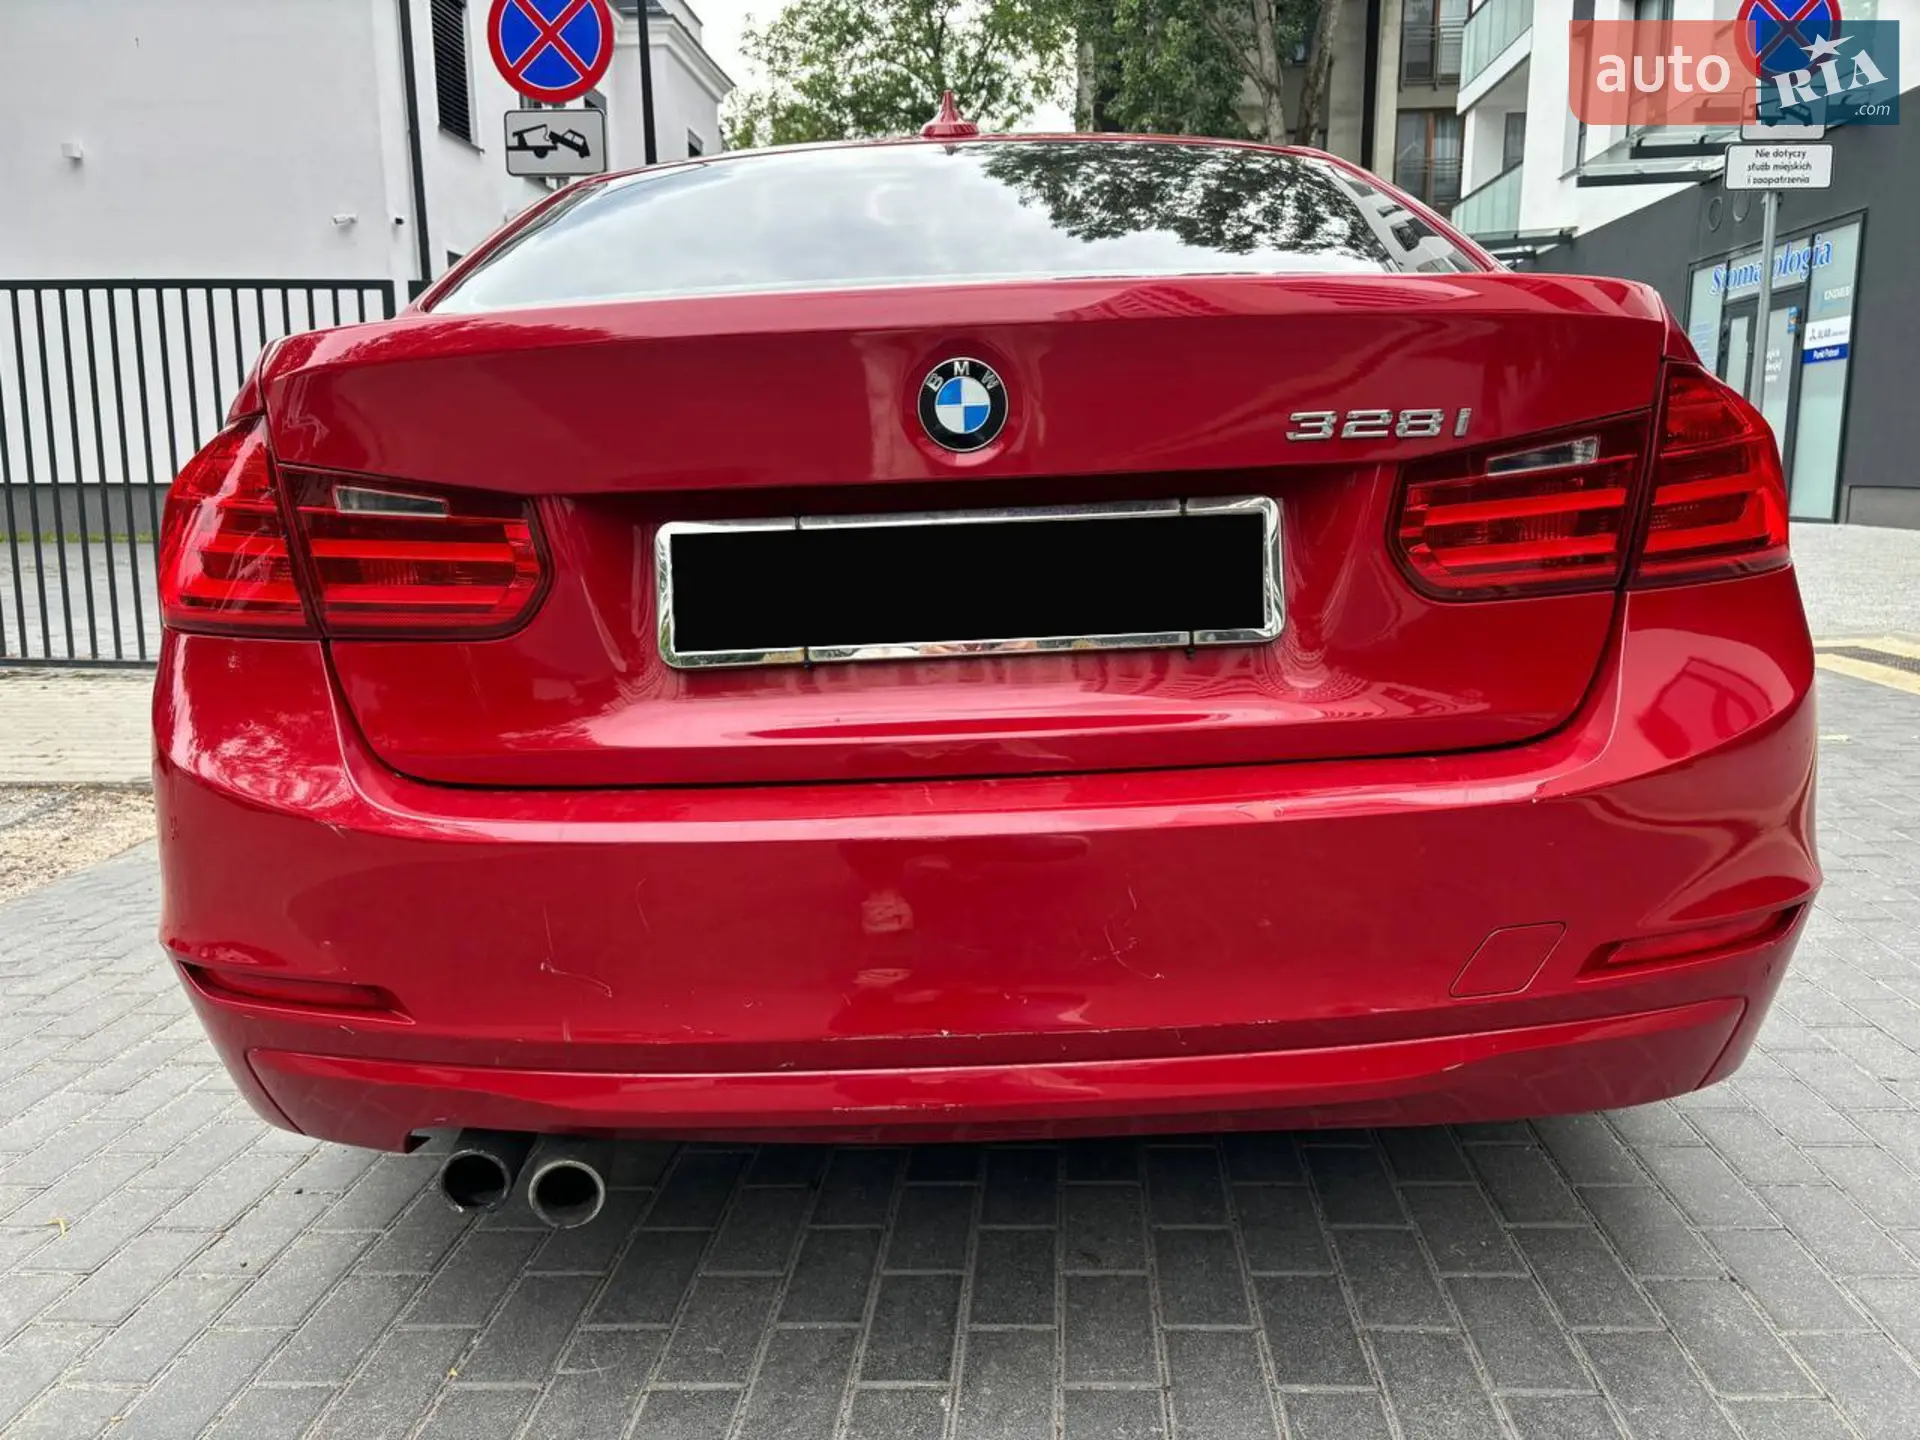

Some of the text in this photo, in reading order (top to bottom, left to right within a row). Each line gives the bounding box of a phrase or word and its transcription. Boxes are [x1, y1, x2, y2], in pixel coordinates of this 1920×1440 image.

[1755, 148, 1806, 159] Nie dotyczy
[1772, 160, 1812, 172] miejskich
[1753, 175, 1810, 186] zaopatrzenia
[1709, 233, 1833, 295] Somaologia
[925, 361, 1000, 392] BMW
[1285, 407, 1472, 441] 328i
